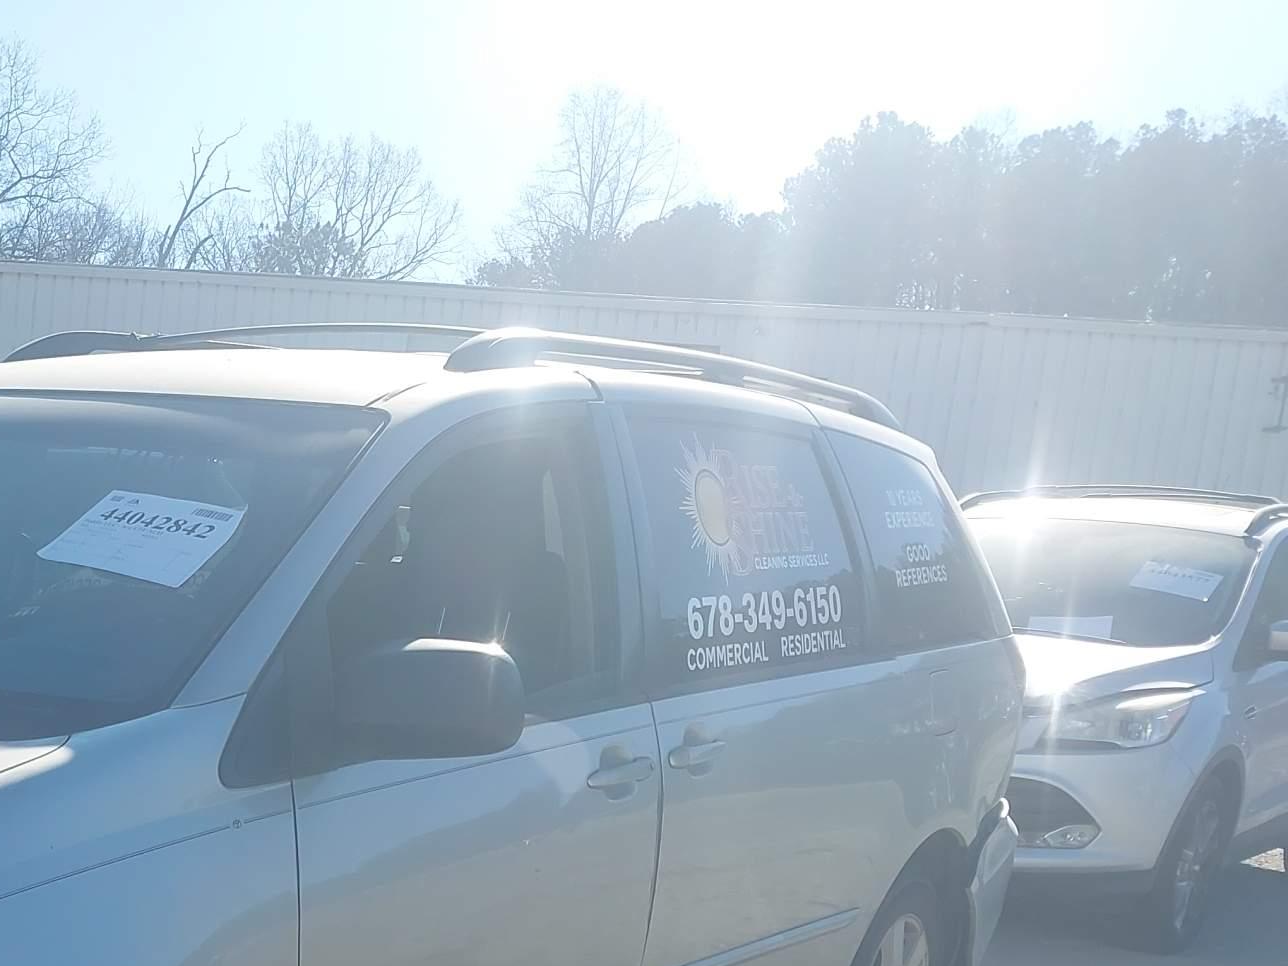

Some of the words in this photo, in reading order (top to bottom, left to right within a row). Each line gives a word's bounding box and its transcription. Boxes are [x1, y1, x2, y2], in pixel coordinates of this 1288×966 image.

[100, 508, 216, 539] 44042842
[754, 556, 787, 570] CLEANING
[788, 554, 818, 569] SERVICES
[818, 552, 830, 566] LLC
[906, 543, 930, 562] GOOD
[895, 564, 948, 588] REFERENCES
[687, 584, 842, 640] 678-349-6150
[687, 641, 769, 671] COMMERCIAL
[780, 629, 846, 657] RESIDENTIAL
